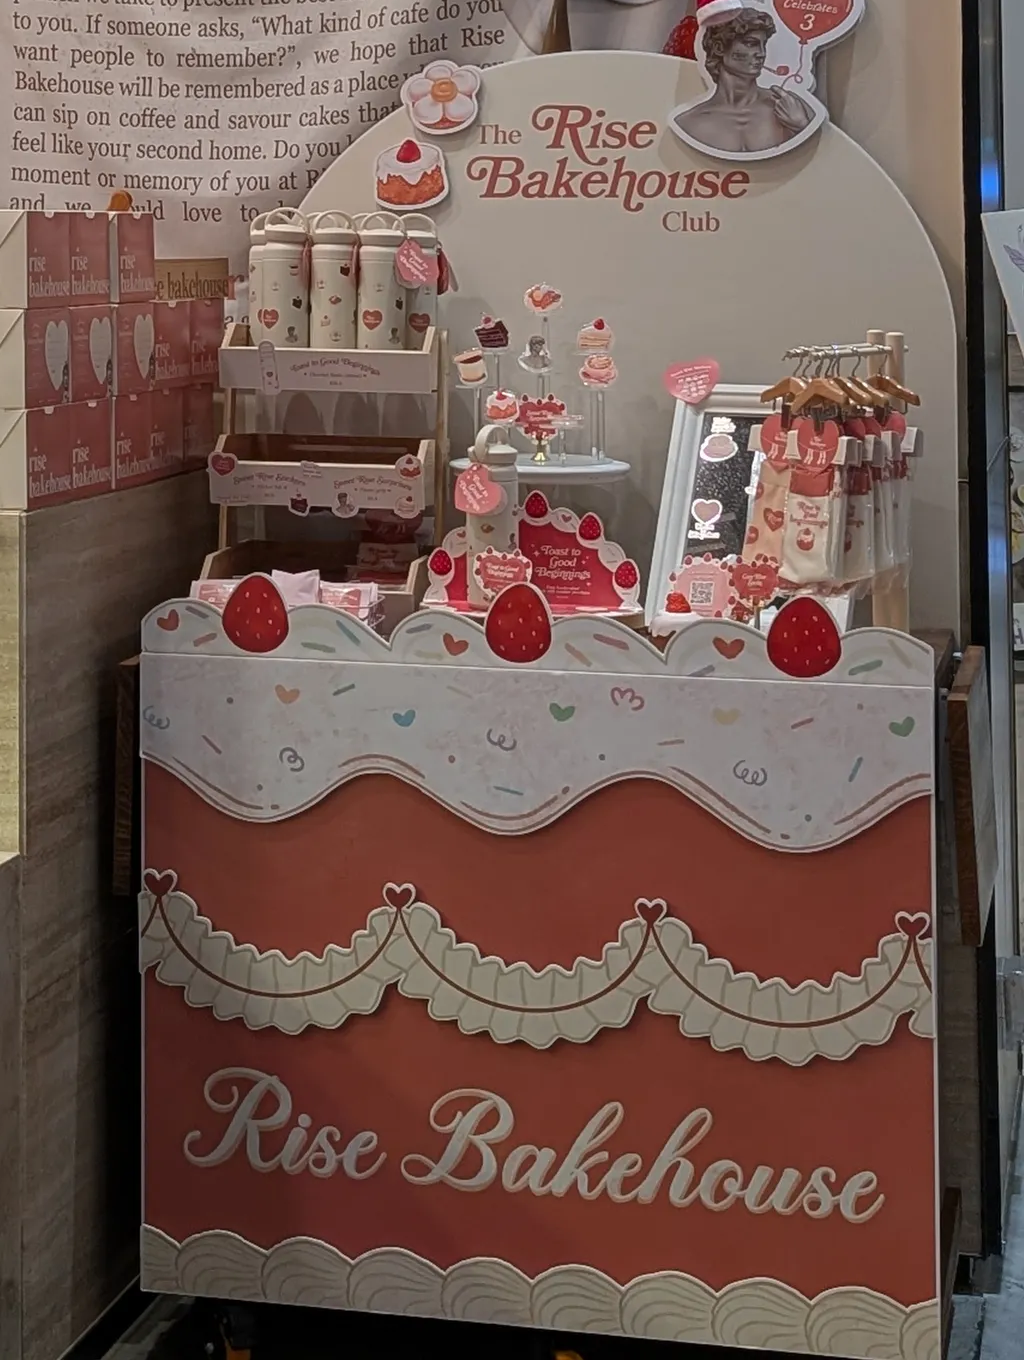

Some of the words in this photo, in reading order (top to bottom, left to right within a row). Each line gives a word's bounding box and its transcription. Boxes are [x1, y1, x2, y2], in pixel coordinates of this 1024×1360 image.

[799, 13, 816, 31] 3
[478, 124, 522, 145] The
[532, 104, 657, 166] Rise
[465, 154, 750, 212] Bakehouse
[661, 210, 720, 233] Club
[29, 256, 46, 272] rise
[72, 256, 88, 271] rise
[120, 254, 136, 270] rise
[29, 275, 70, 298] bakehouse
[71, 274, 110, 295] bakehouse
[167, 272, 228, 298] bakehouse
[155, 343, 170, 358] rise
[72, 447, 90, 464] rise
[117, 439, 131, 455] rise
[29, 454, 47, 472] rise
[29, 474, 71, 498] bakehouse
[72, 466, 111, 489] bakehouse
[540, 545, 569, 556] Toast
[571, 548, 581, 556] to
[549, 556, 577, 569] Good
[535, 567, 591, 580] Beginnings
[183, 1066, 388, 1180] Rise
[401, 1087, 886, 1224] Bakehouse
